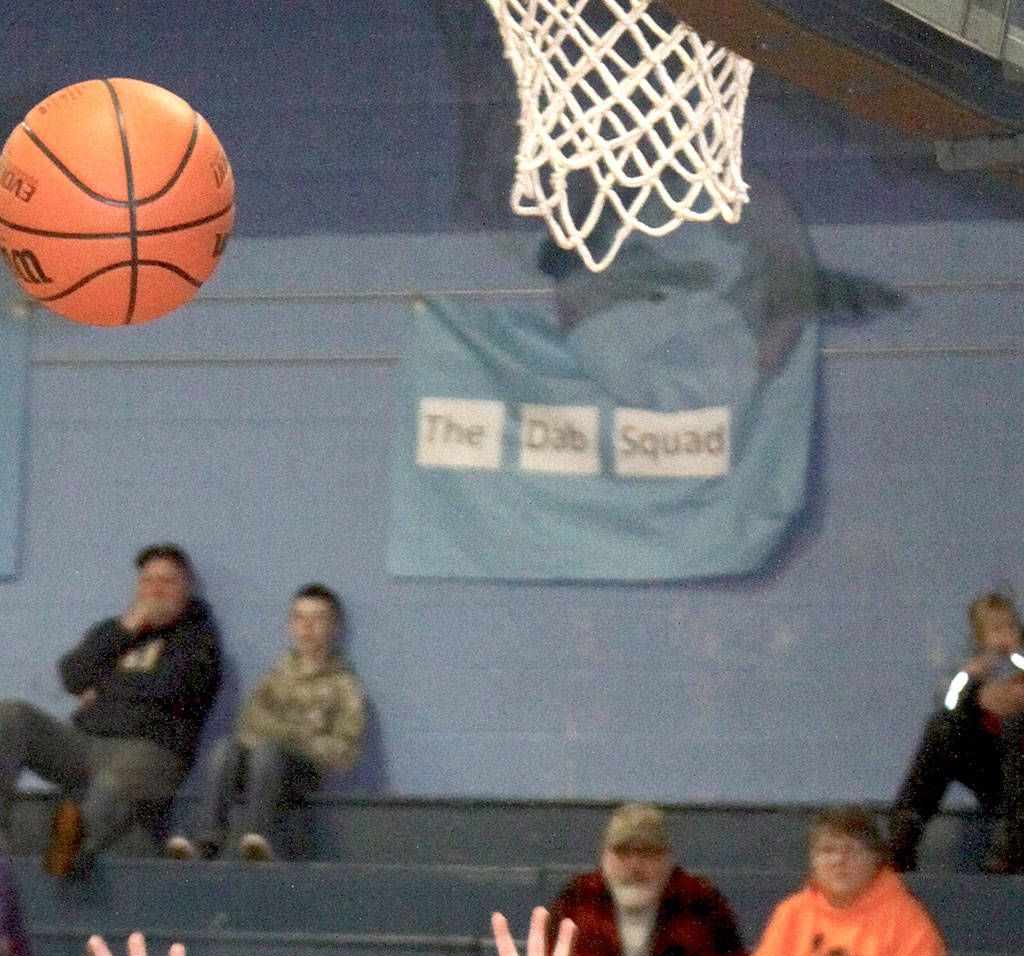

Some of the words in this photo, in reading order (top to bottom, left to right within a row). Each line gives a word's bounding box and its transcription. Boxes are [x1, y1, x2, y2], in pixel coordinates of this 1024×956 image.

[422, 414, 488, 449] The
[527, 419, 590, 452] Dab
[621, 421, 727, 461] Squad
